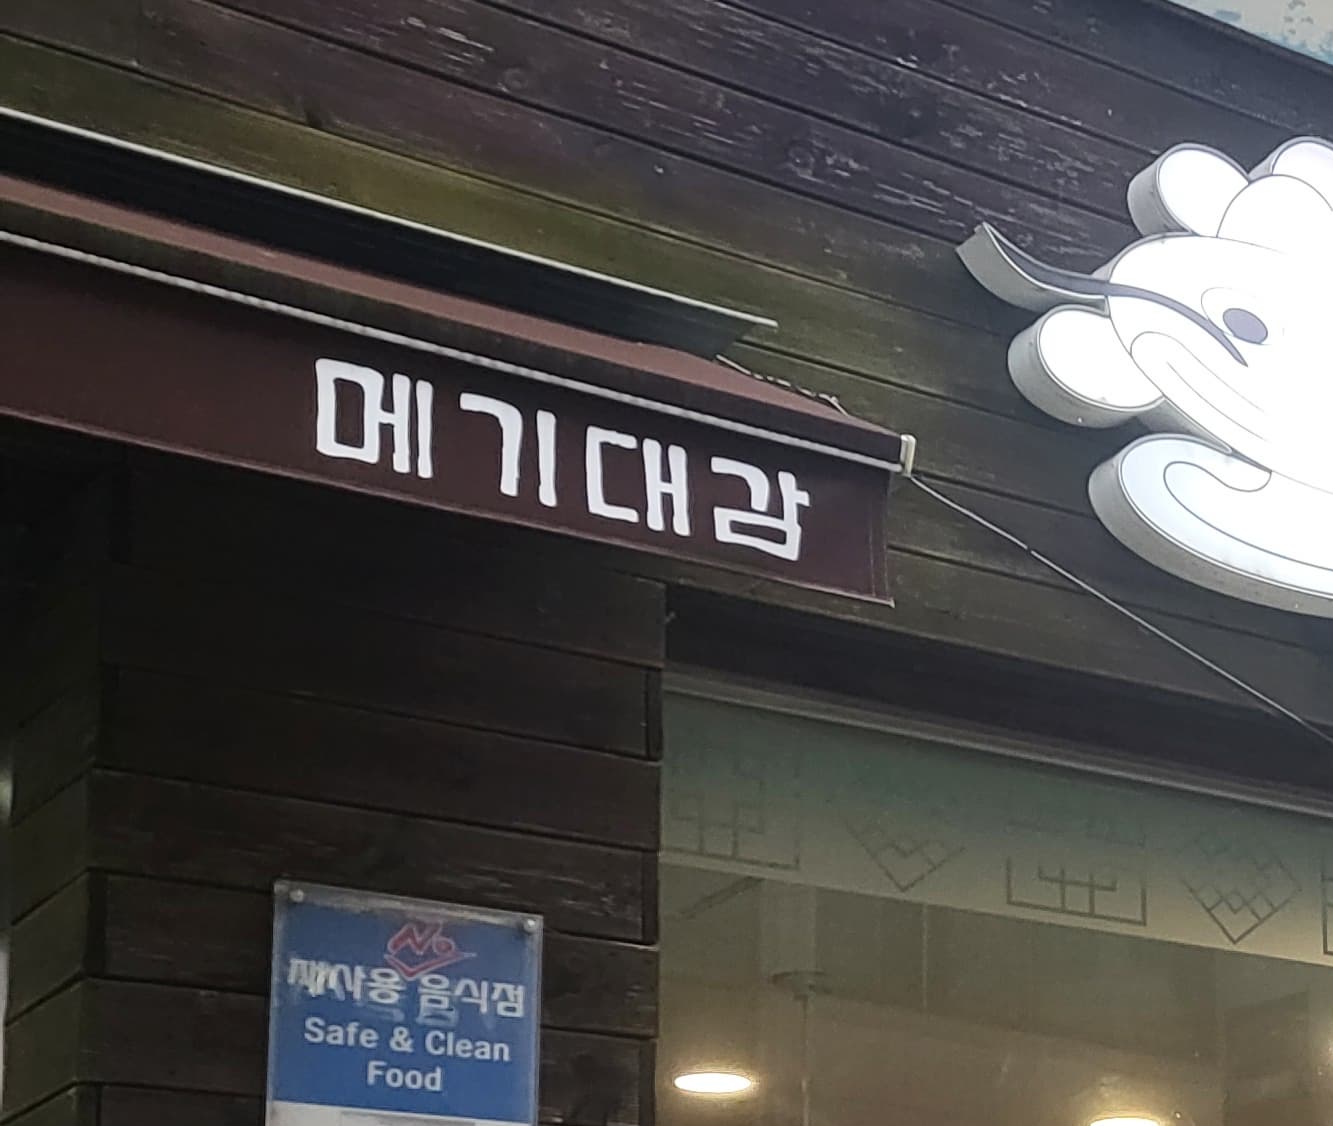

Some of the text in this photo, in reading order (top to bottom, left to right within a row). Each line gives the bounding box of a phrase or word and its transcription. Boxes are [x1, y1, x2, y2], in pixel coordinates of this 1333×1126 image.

[315, 357, 810, 562] 메기대감
[417, 973, 526, 1018] 음식점
[304, 1017, 511, 1063] Safe & Clean
[366, 1060, 443, 1092] Food
